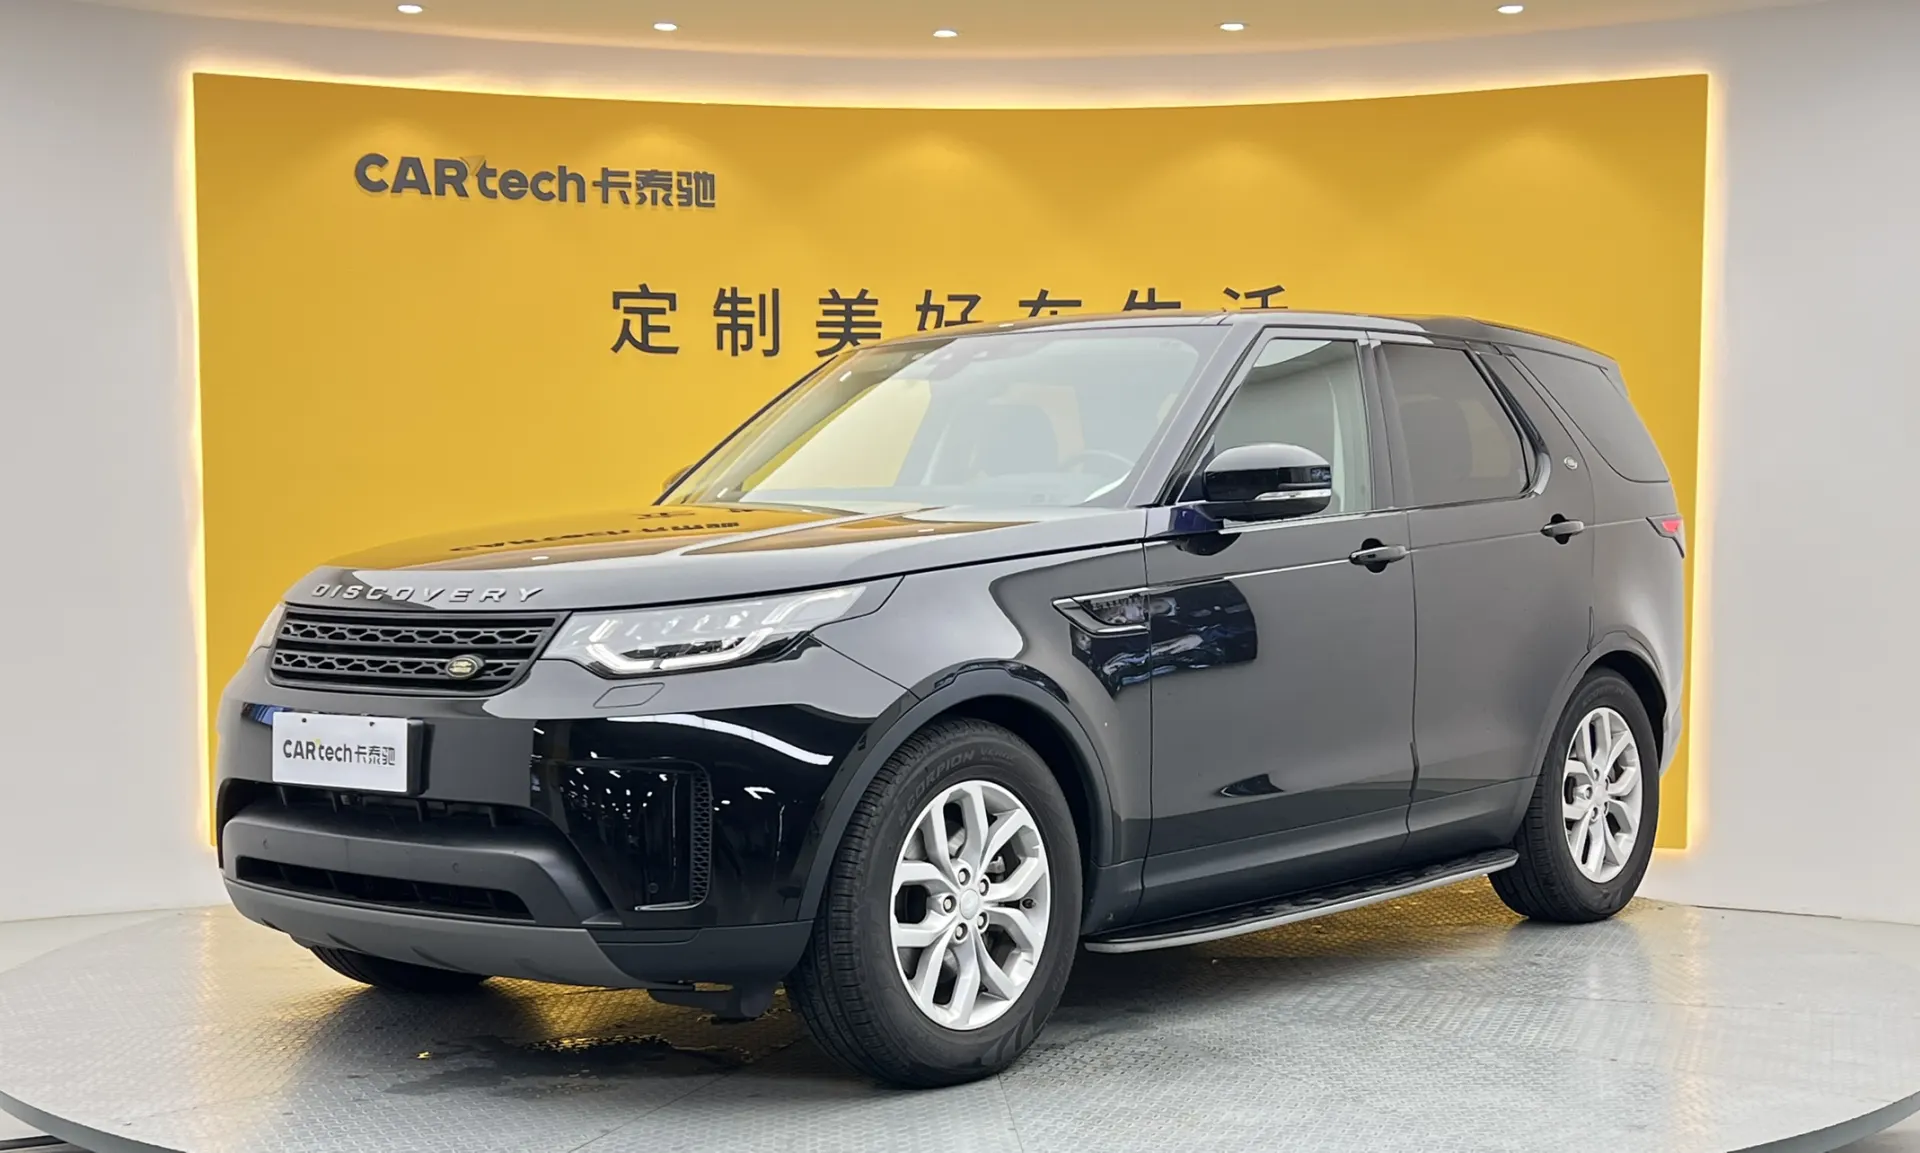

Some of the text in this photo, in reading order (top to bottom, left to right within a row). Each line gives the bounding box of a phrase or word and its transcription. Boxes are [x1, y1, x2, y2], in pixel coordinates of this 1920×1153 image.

[354, 152, 716, 209] CARtech 卡泰驰
[310, 582, 545, 603] DISCOVERY
[282, 738, 353, 763] CARtech
[898, 748, 976, 828] SCORPION
